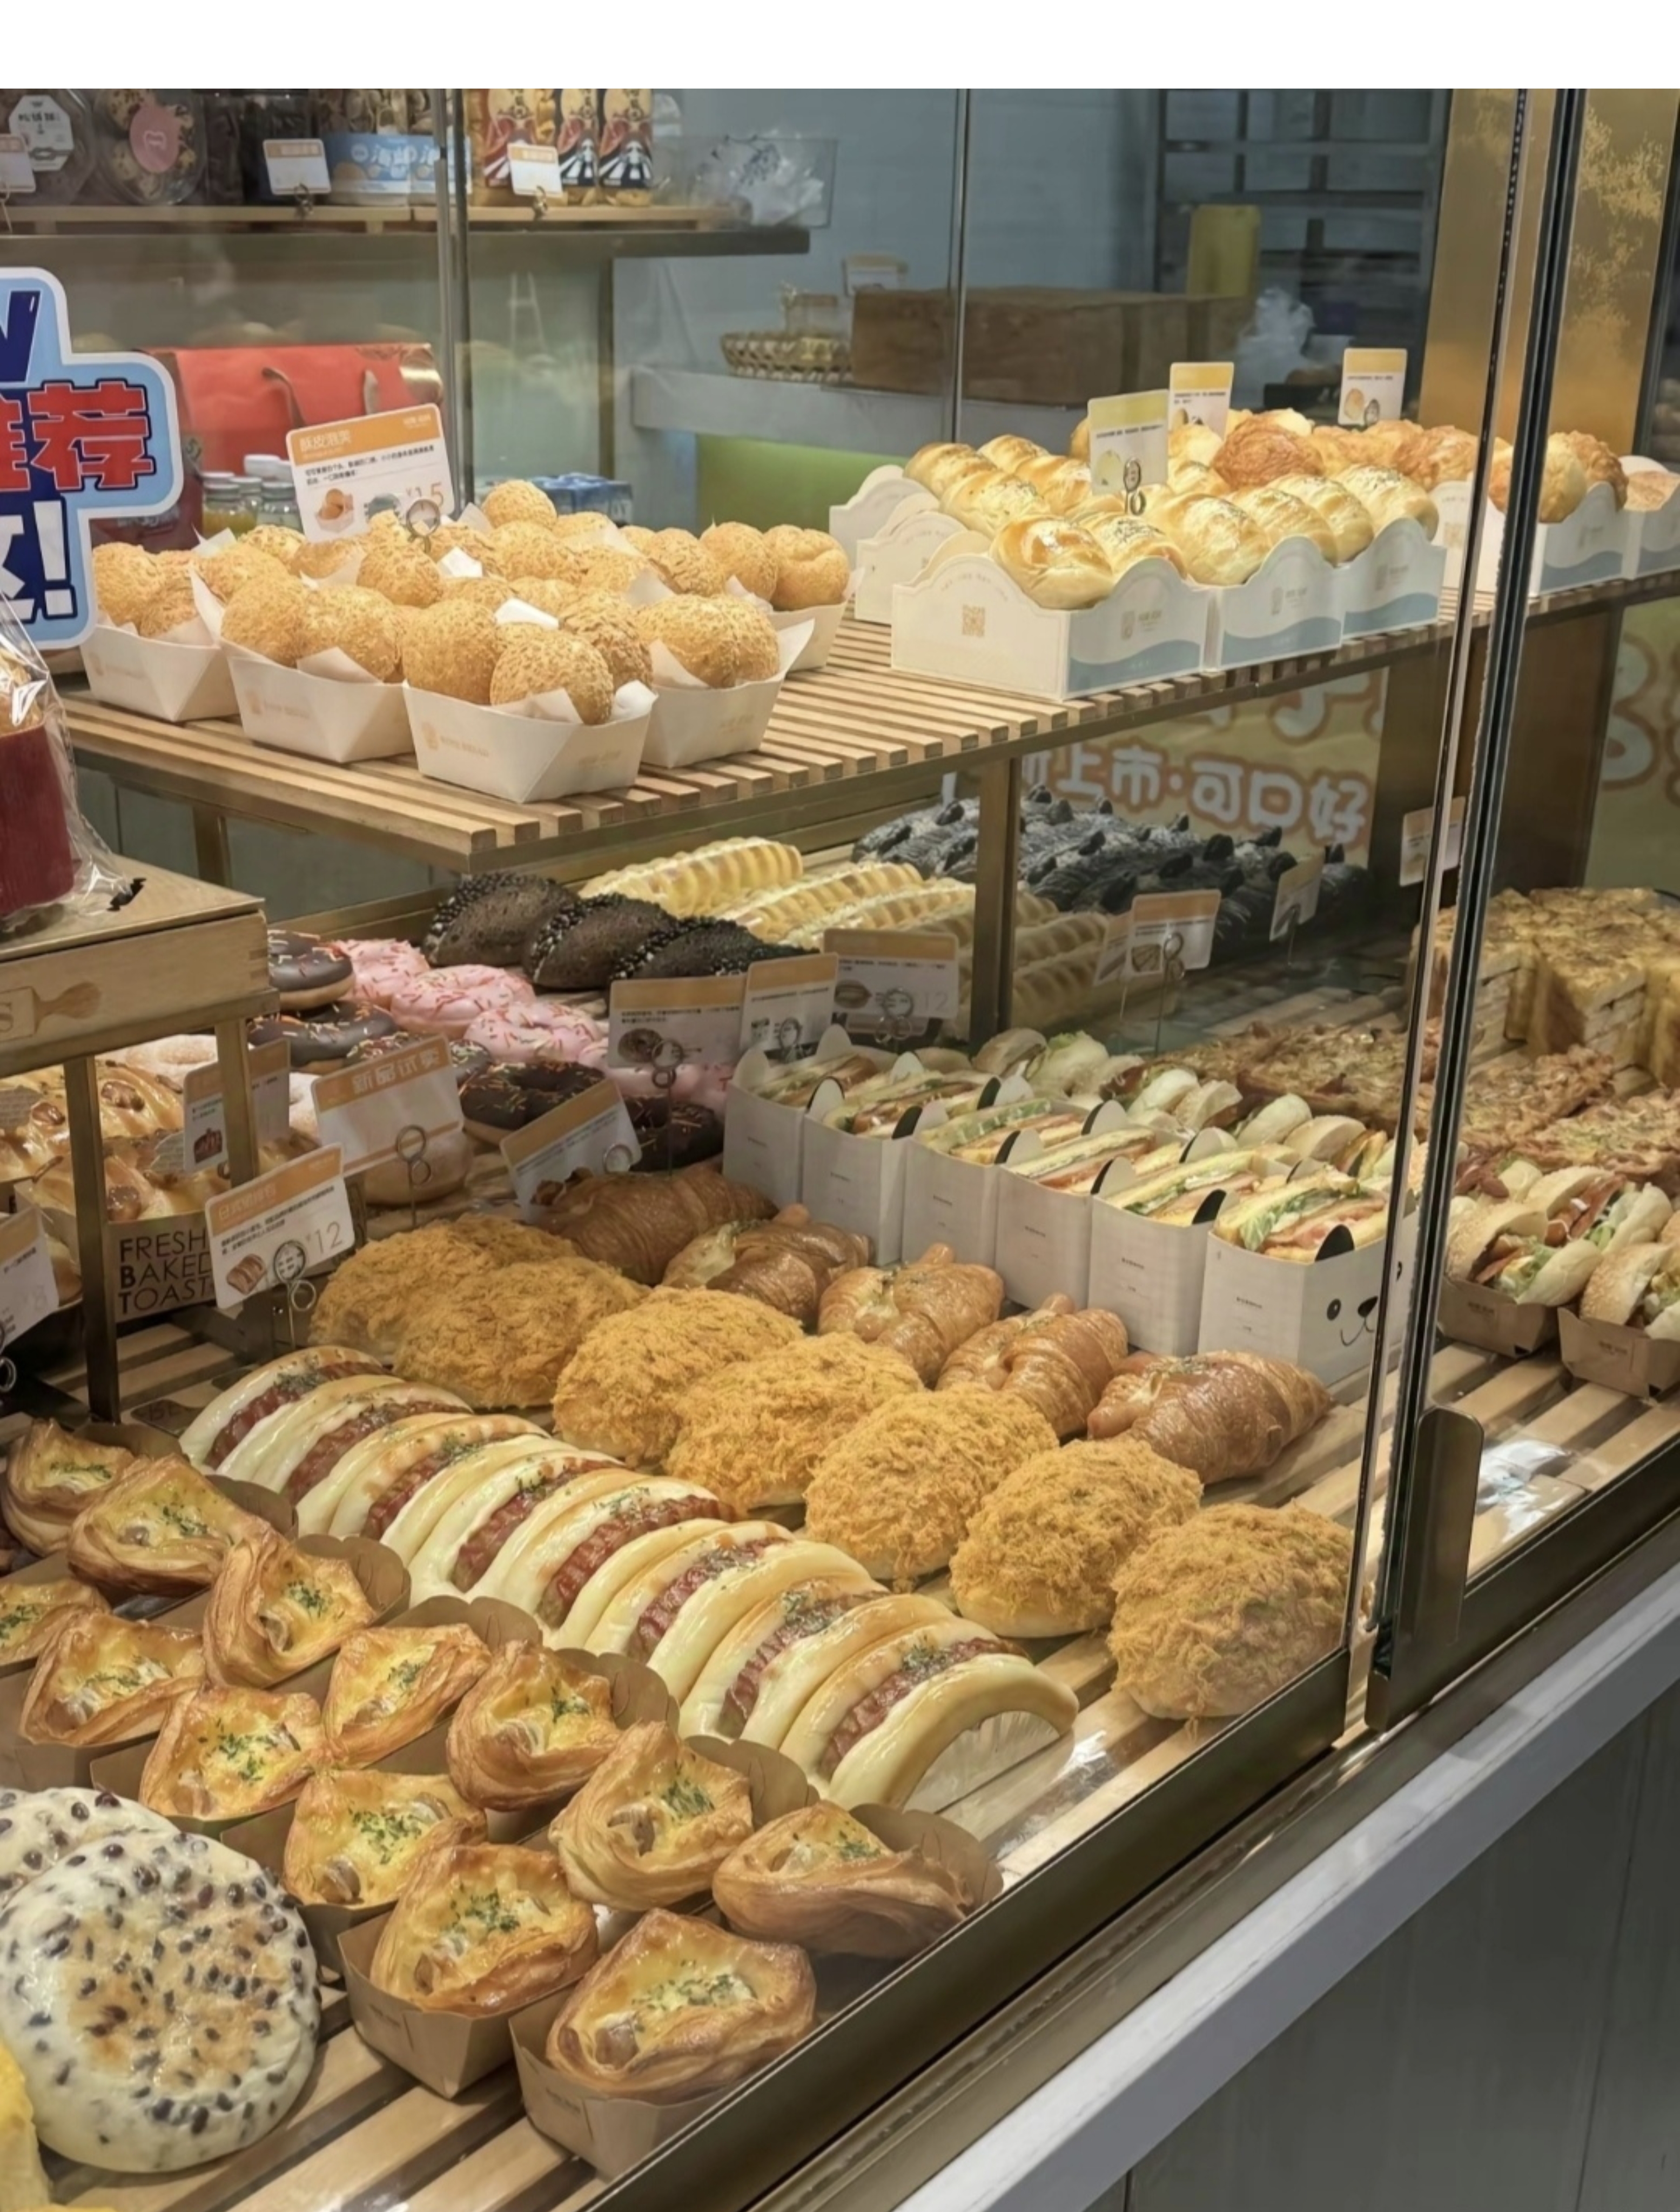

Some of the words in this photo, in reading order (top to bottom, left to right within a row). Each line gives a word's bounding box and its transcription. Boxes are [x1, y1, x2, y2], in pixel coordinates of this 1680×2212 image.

[0, 380, 156, 493] 荐
[120, 1228, 206, 1263] FRESH
[120, 1251, 212, 1290] BAKED
[118, 1276, 211, 1314] TOAST
